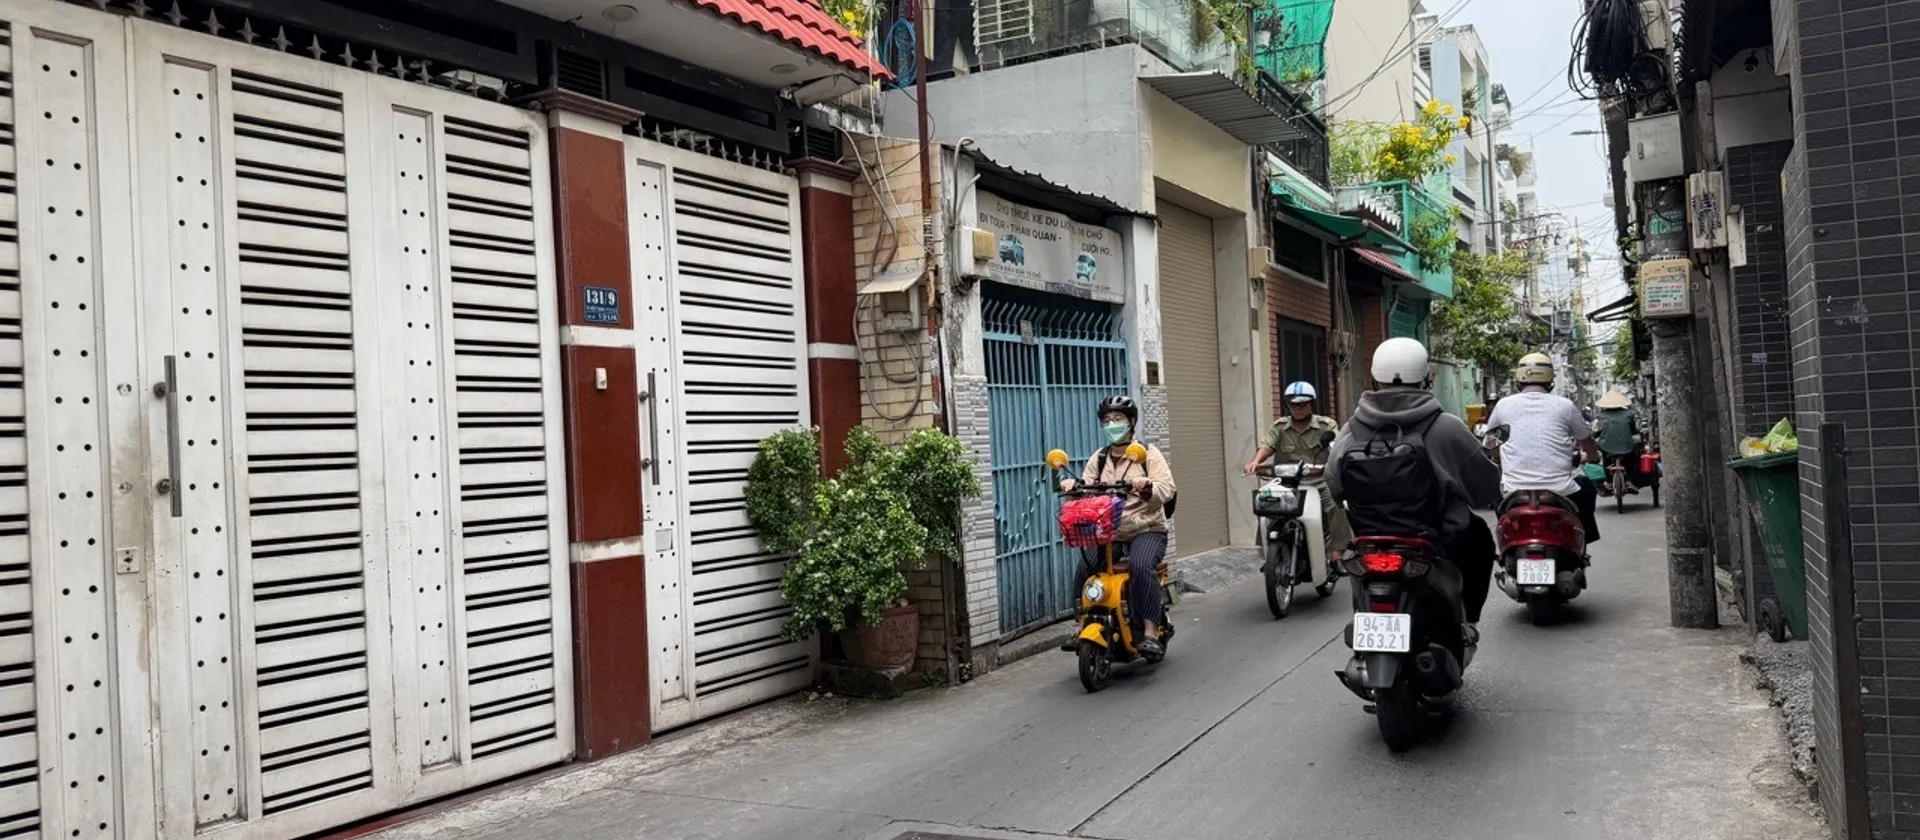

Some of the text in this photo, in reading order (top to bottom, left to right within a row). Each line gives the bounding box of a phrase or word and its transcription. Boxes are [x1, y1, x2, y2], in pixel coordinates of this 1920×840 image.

[989, 215, 1005, 228] TOUR
[1032, 229, 1057, 242] QUAN
[1032, 214, 1044, 224] XE
[1046, 216, 1058, 227] DU
[586, 289, 616, 306] 131/9
[1363, 616, 1401, 632] 94-AA
[1357, 633, 1406, 649] 263.21
